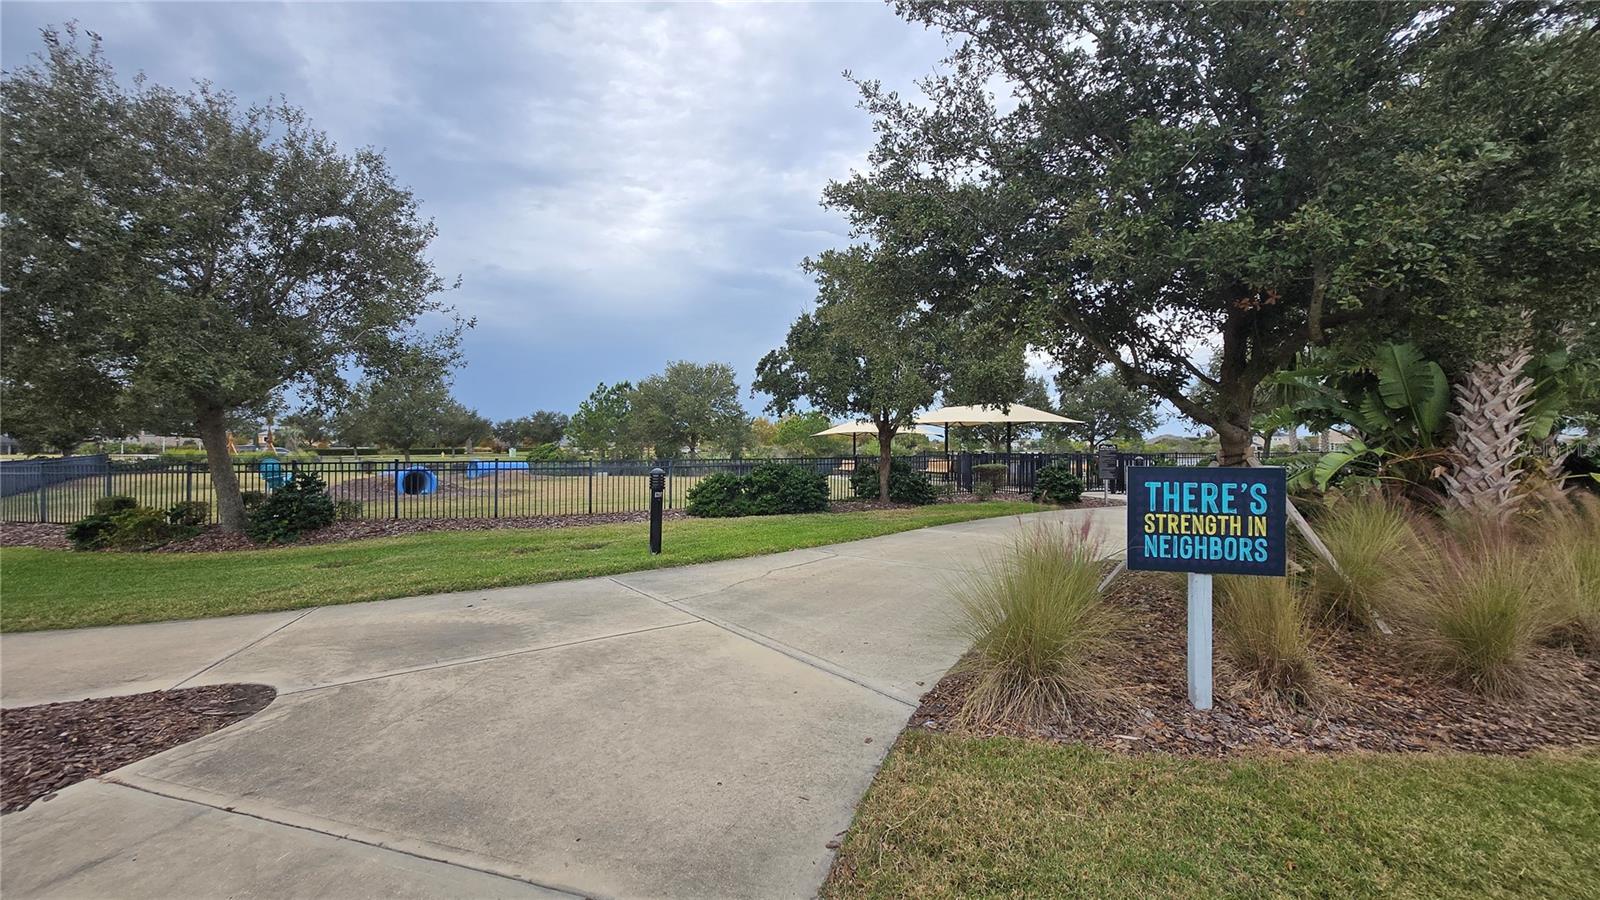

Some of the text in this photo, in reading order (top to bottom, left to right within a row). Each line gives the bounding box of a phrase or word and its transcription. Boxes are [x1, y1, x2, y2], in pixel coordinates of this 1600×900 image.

[1144, 481, 1268, 515] THERE'S
[1144, 513, 1267, 537] STRENGTH IN
[1144, 534, 1268, 562] NEIGHBORS
